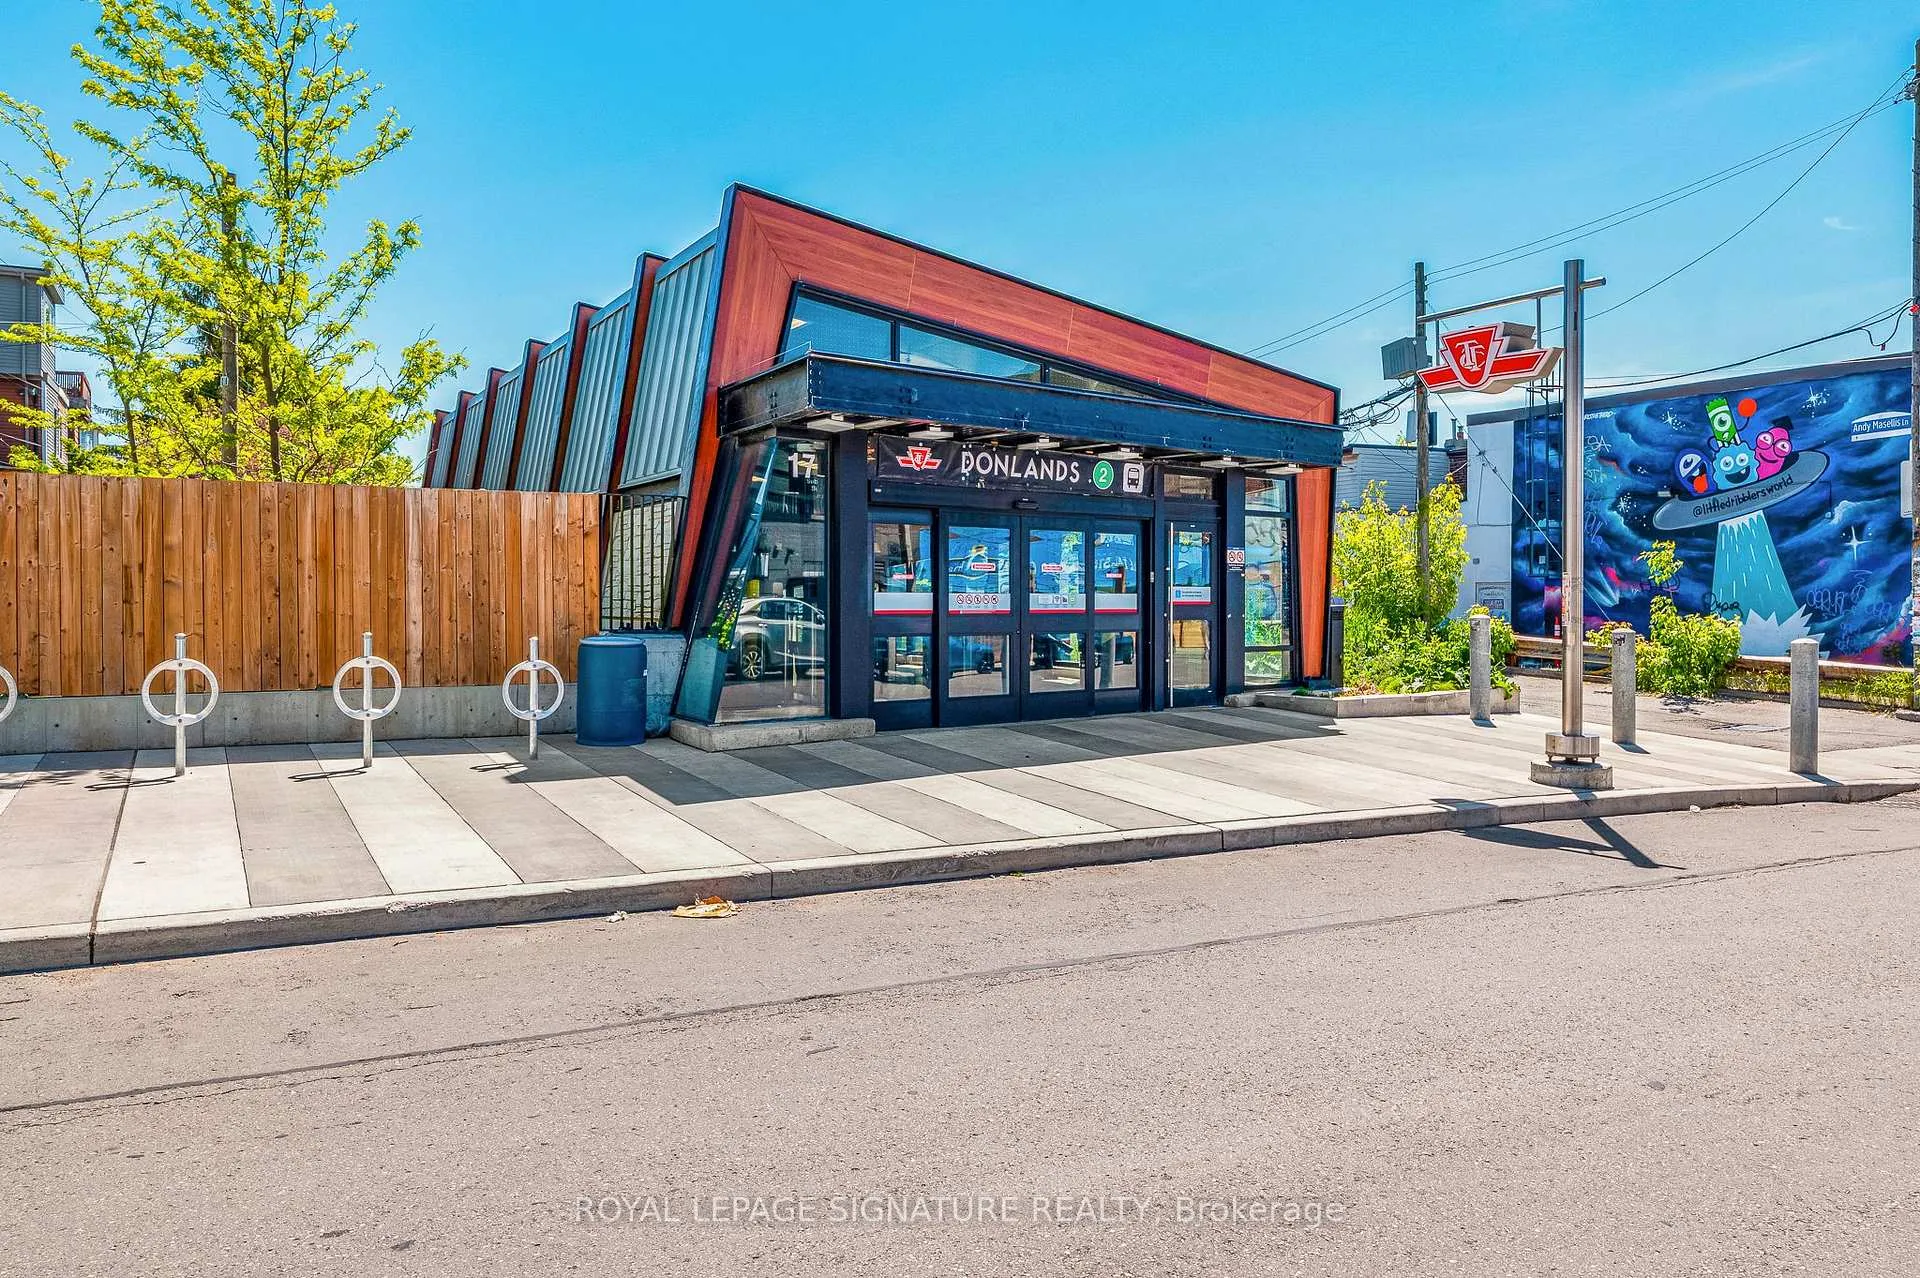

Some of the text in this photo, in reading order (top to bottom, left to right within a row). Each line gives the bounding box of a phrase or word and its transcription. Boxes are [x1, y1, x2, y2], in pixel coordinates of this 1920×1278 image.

[1853, 422, 1871, 432] Andy
[1902, 418, 1909, 426] Ln
[961, 451, 1108, 483] DONLANDS 2
[1693, 474, 1794, 518] @littledribblersworld
